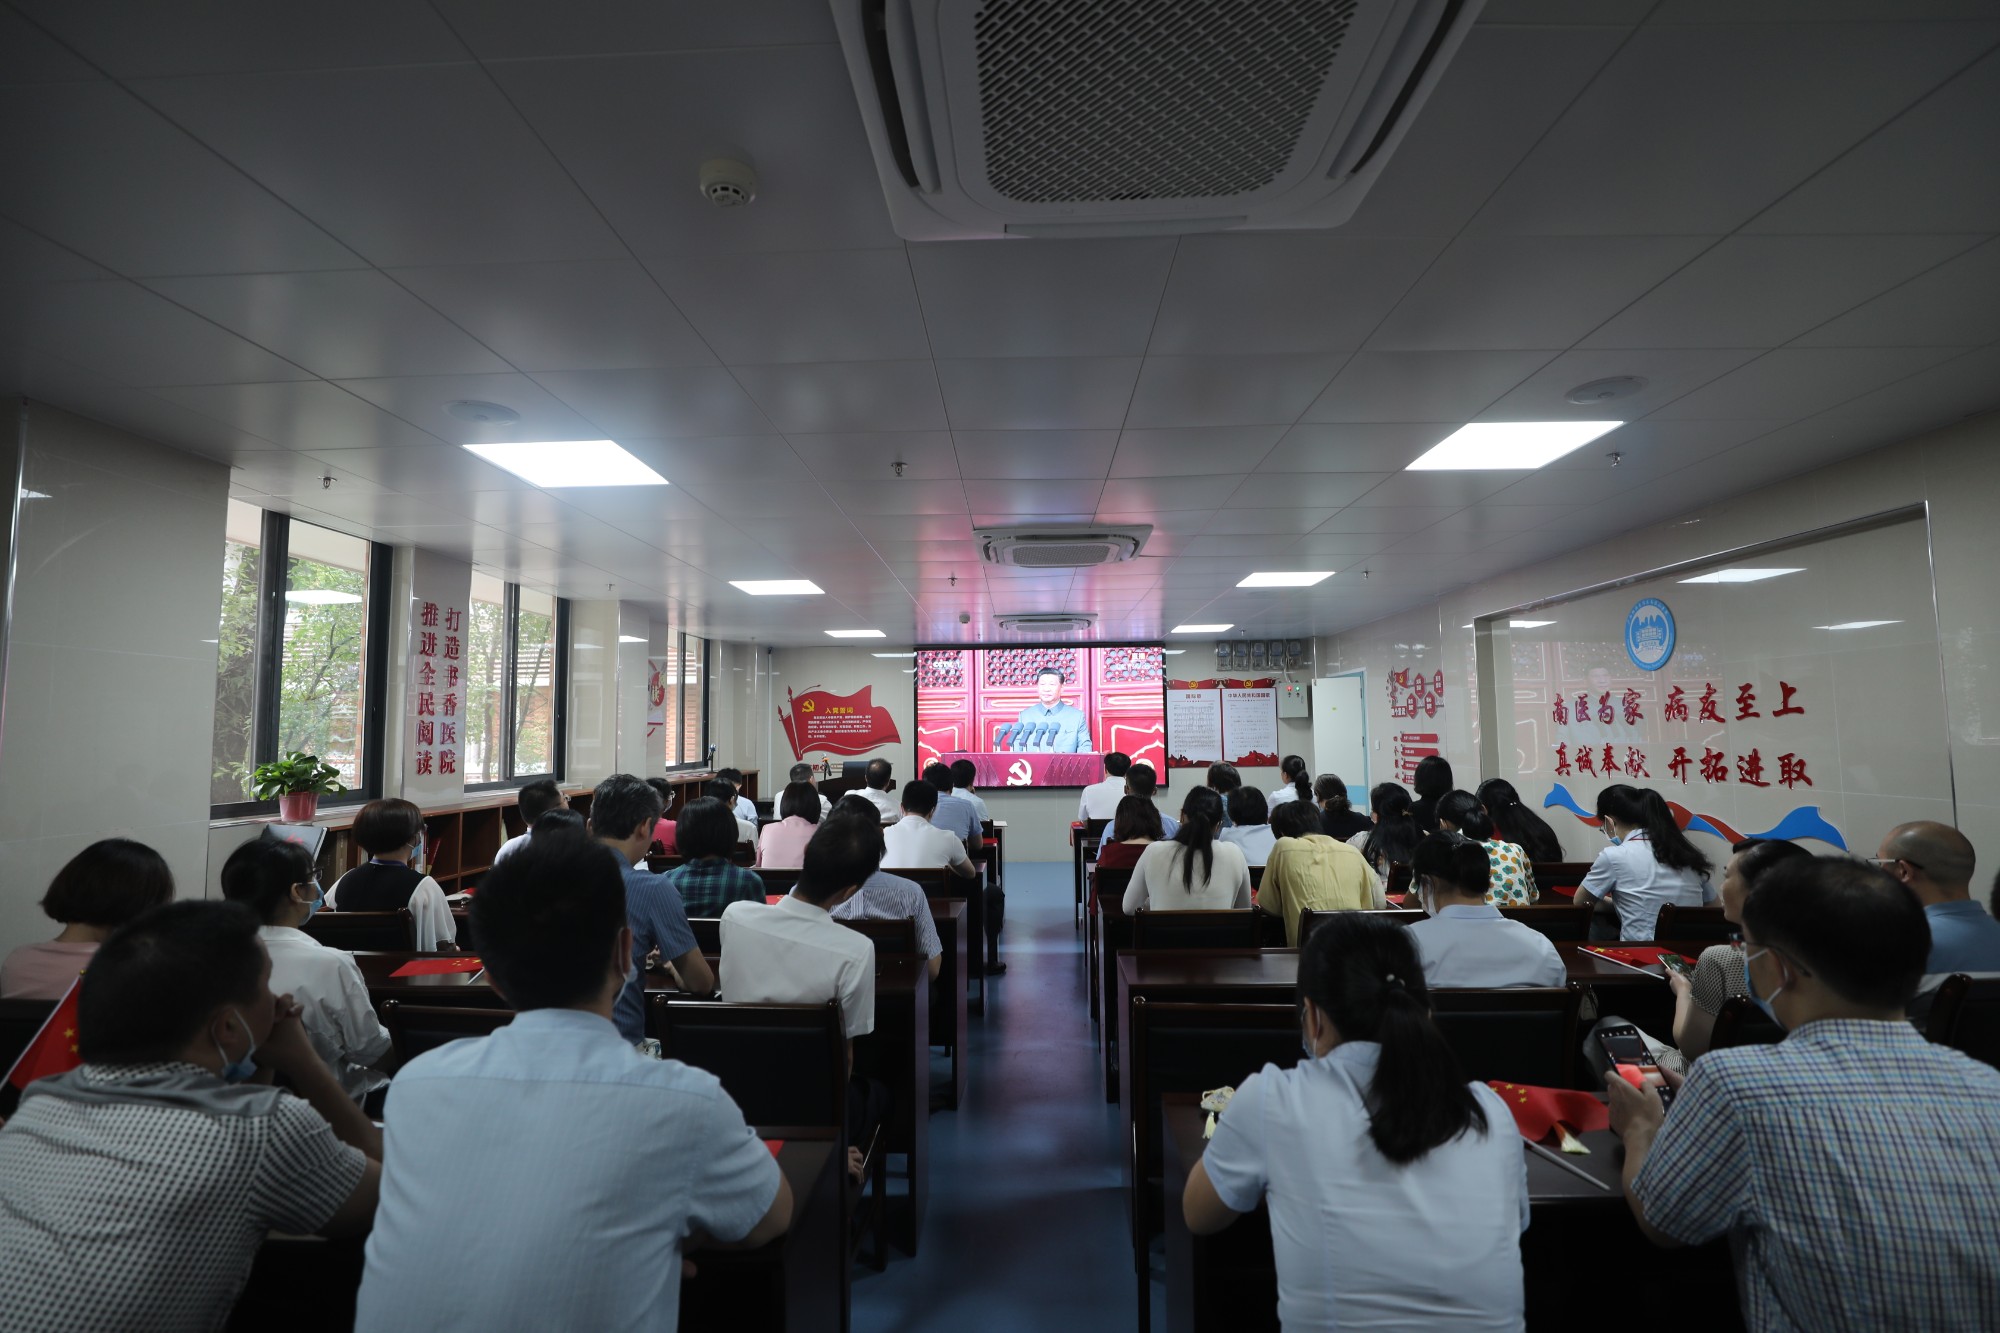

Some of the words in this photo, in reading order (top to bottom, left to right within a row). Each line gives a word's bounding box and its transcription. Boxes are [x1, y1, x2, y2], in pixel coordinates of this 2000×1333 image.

[416, 602, 438, 776] 推进全民阅读
[438, 607, 462, 775] 打造书香医院
[1552, 687, 1645, 726] 南医为家
[1664, 681, 1805, 724] 病友至上
[1554, 742, 1651, 780] 真诚奉献
[1667, 746, 1813, 790] 开拓进取
